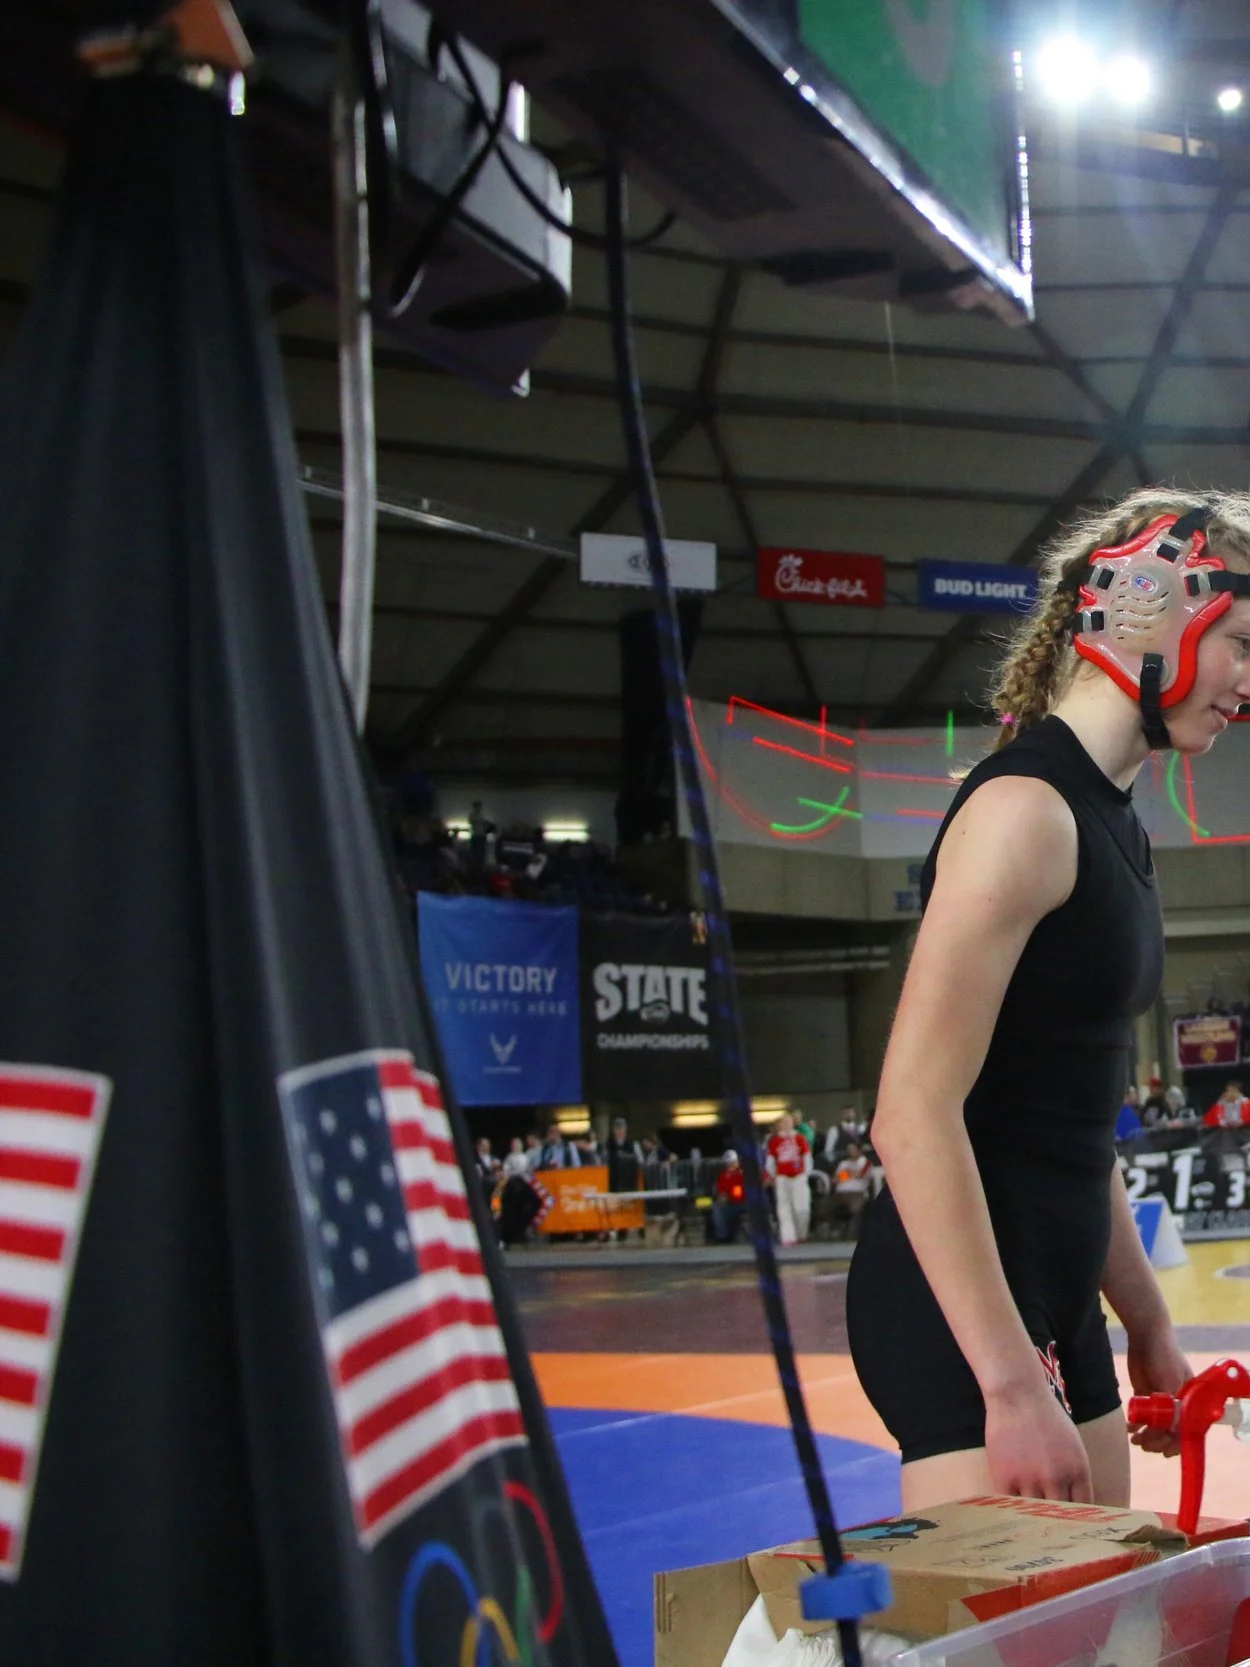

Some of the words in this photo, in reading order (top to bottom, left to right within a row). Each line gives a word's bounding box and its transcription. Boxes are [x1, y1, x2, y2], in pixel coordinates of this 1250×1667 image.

[934, 577, 972, 596] BUD
[975, 580, 1028, 599] LIGHT
[444, 961, 558, 994] VICTORY
[594, 962, 708, 1025] STATE
[458, 998, 521, 1015] STARTS
[597, 1033, 710, 1051] CHAMPIONSHIPS
[1172, 1153, 1194, 1211] 1
[1226, 1170, 1246, 1208] 3
